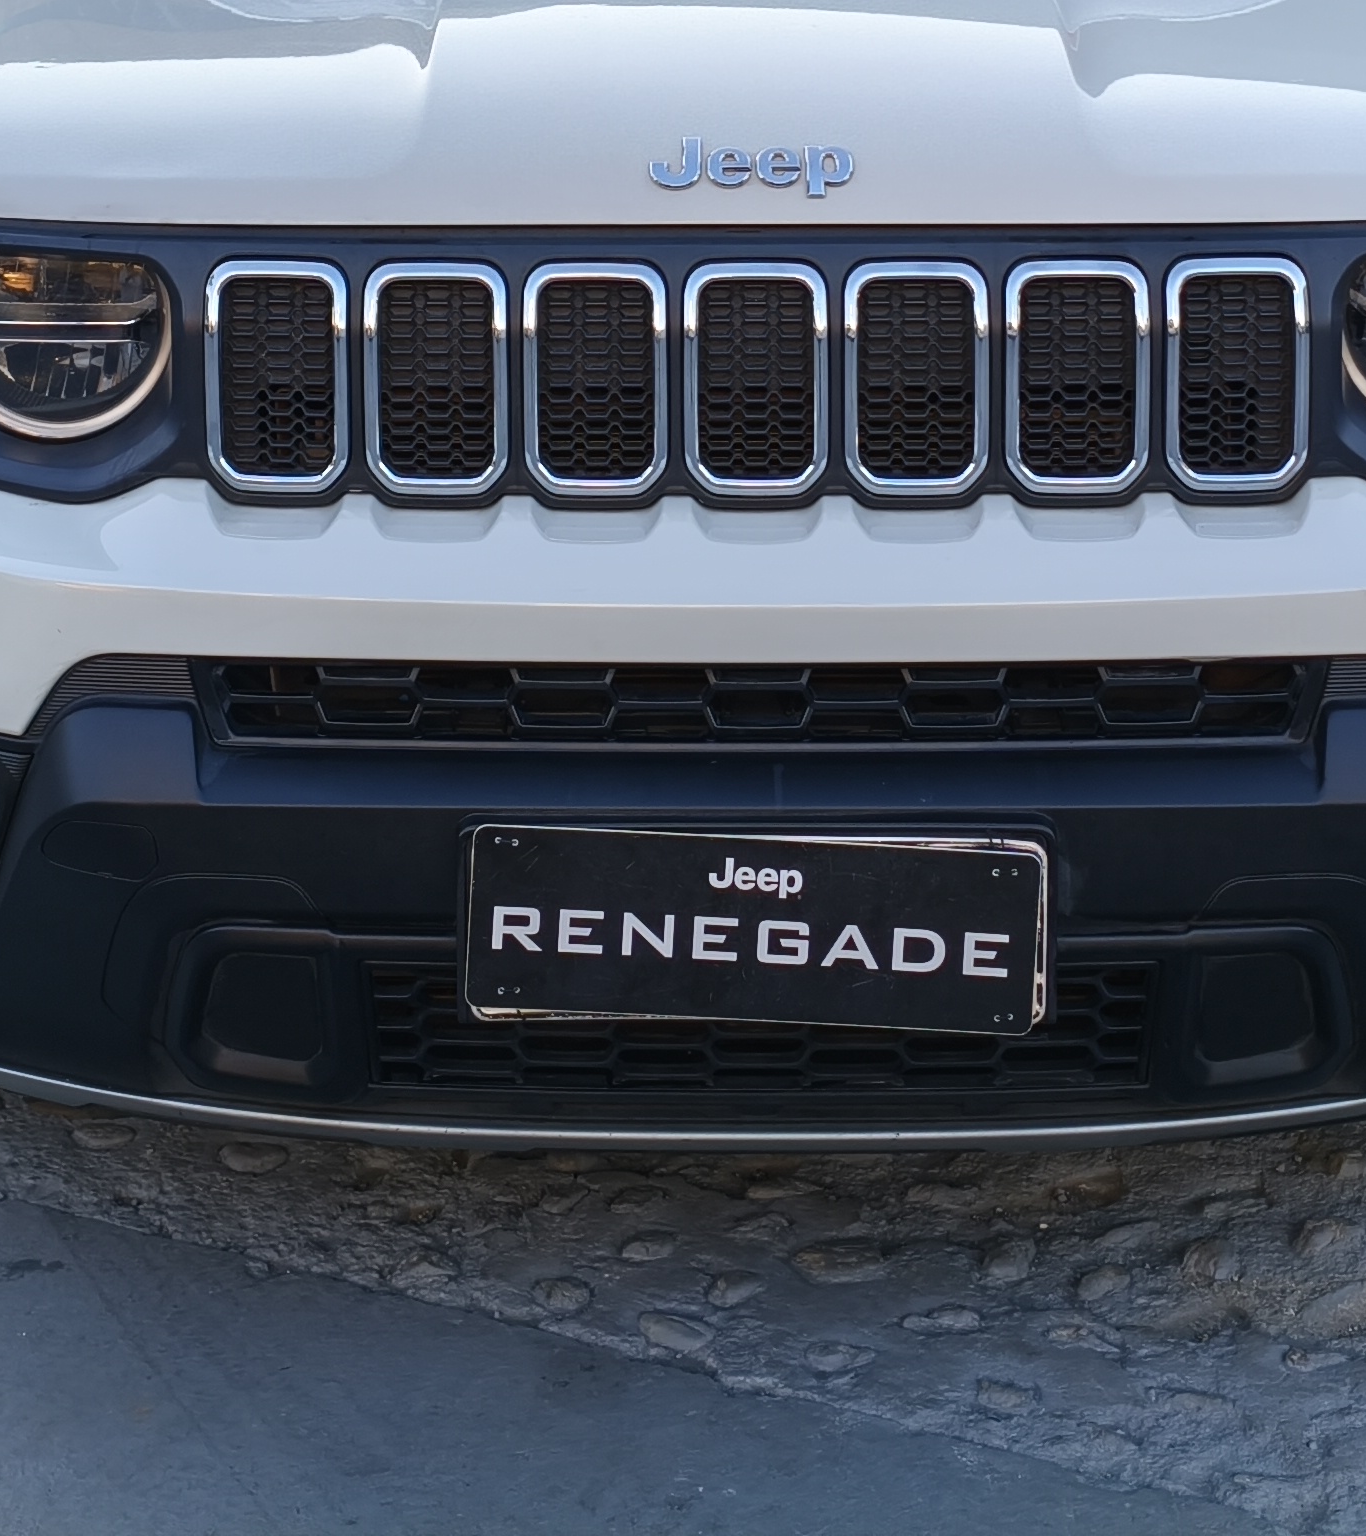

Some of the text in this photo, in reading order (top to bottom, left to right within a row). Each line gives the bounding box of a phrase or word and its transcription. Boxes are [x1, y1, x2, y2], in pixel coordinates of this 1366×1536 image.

[648, 136, 855, 199] Jeep
[708, 857, 803, 899] Jeep
[490, 905, 1011, 979] RENEGADE
